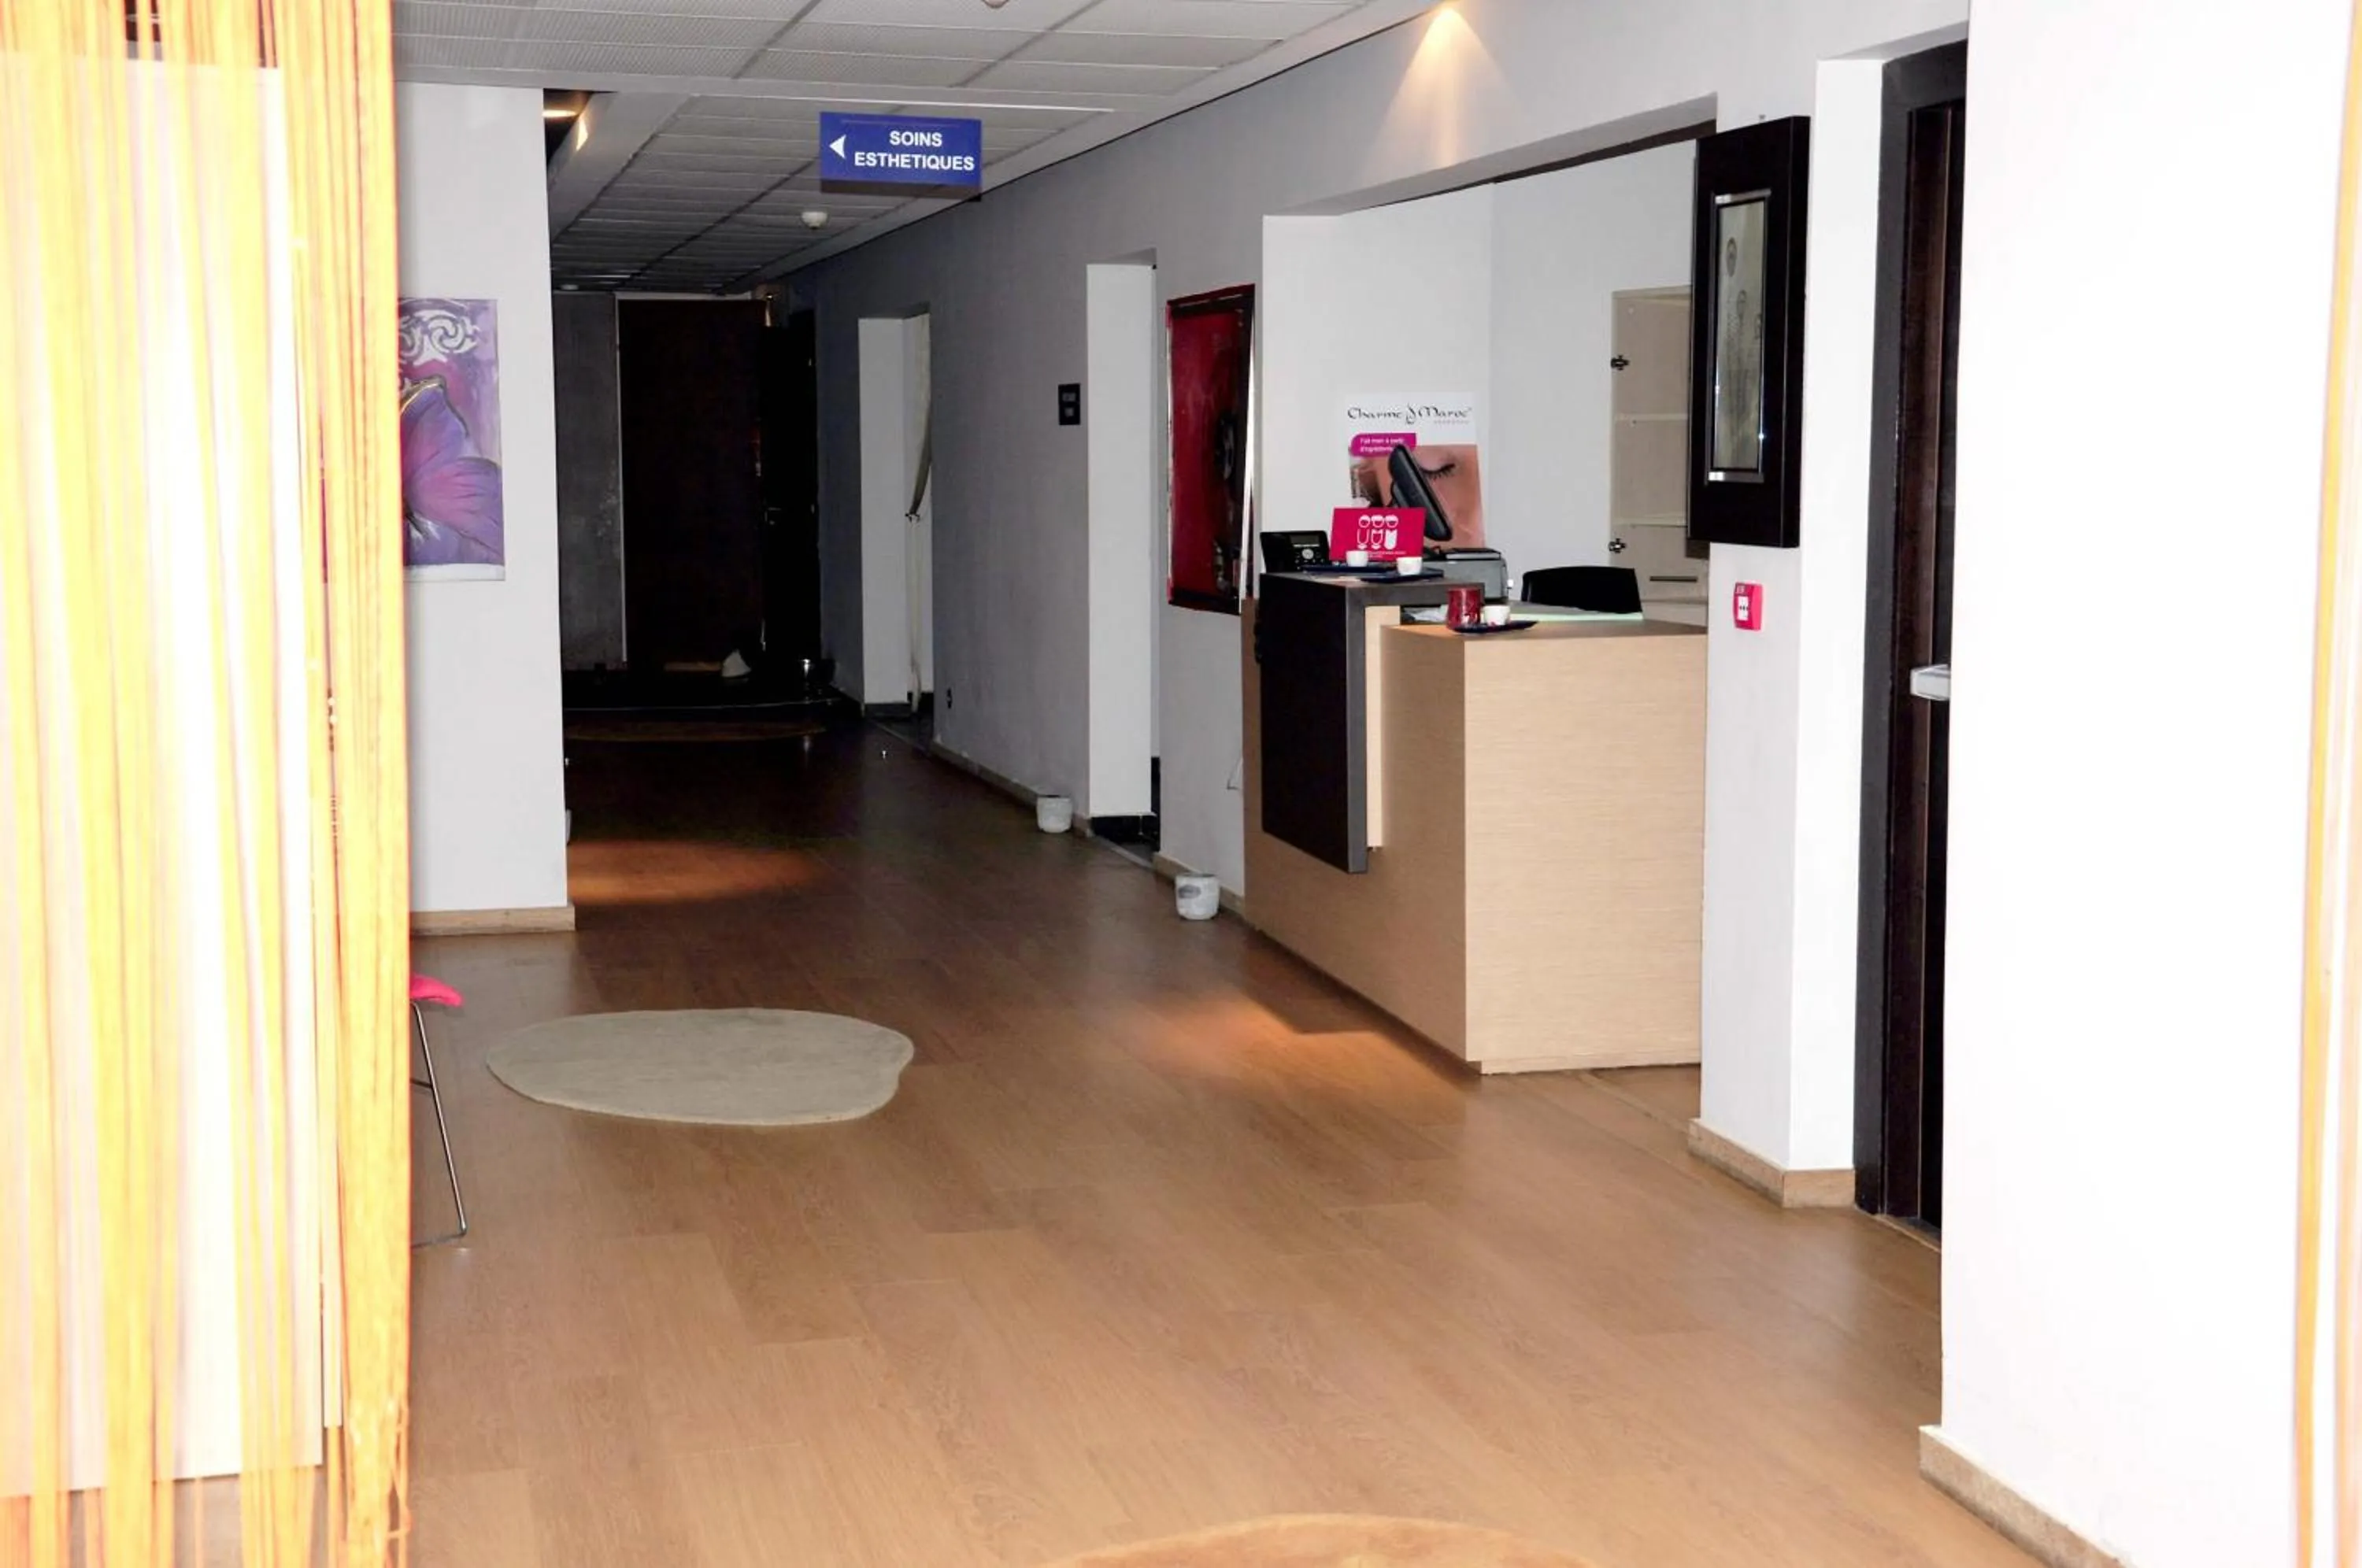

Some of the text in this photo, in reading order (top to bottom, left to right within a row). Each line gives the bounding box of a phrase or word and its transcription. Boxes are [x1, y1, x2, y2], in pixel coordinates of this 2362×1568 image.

[889, 130, 942, 147] SOINS
[854, 152, 975, 171] ESTHETIQUES
[1347, 406, 1401, 420] Charme
